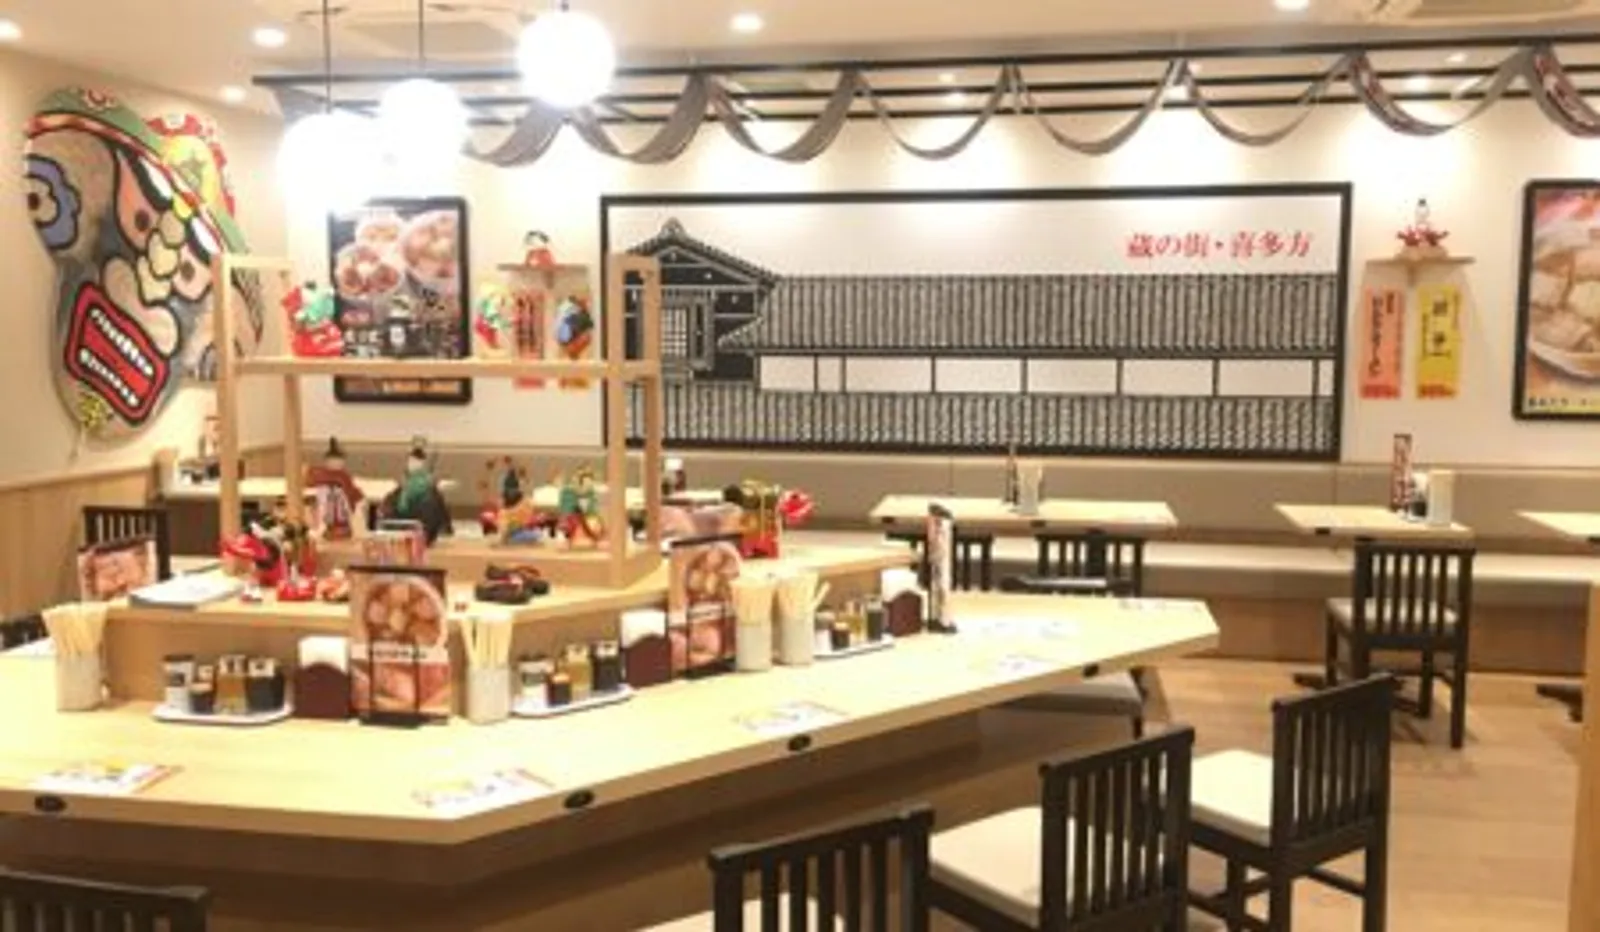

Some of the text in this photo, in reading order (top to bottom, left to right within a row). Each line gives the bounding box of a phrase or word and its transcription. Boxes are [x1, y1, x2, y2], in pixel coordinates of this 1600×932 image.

[1129, 231, 1311, 257] 蔵の街・喜多方
